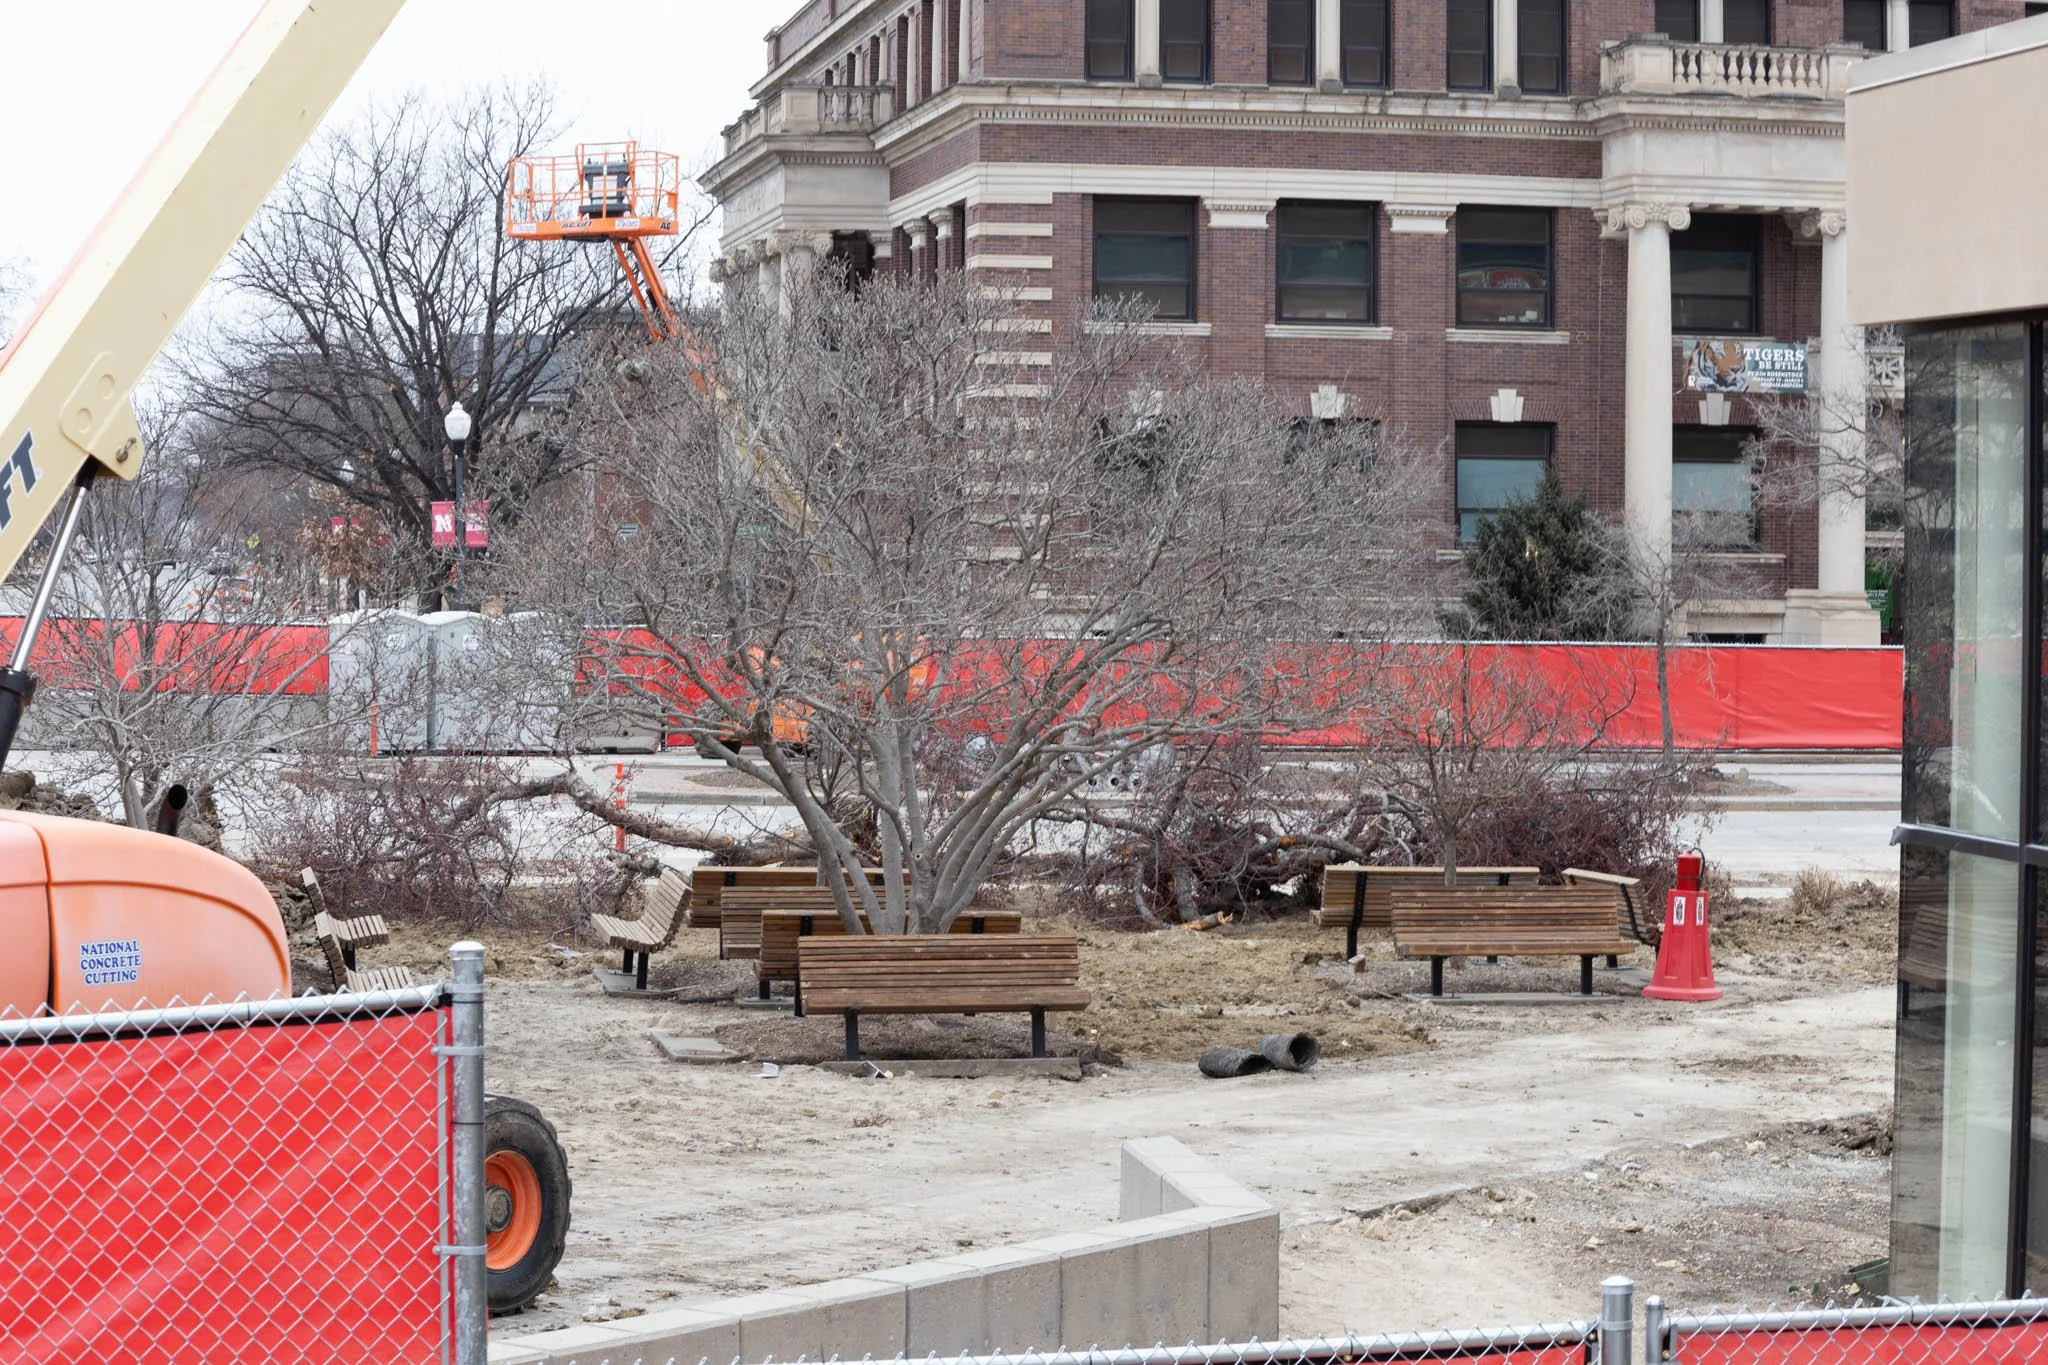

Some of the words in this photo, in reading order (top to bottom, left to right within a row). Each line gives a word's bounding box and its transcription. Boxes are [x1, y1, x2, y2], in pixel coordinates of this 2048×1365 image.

[1743, 348, 1804, 362] TIGERS
[1759, 360, 1772, 370] BE
[1774, 361, 1804, 371] STILL
[435, 514, 453, 532] N
[81, 940, 140, 955] NATIONAL
[80, 955, 141, 970] CONCRETE
[85, 970, 137, 984] CUTTING
